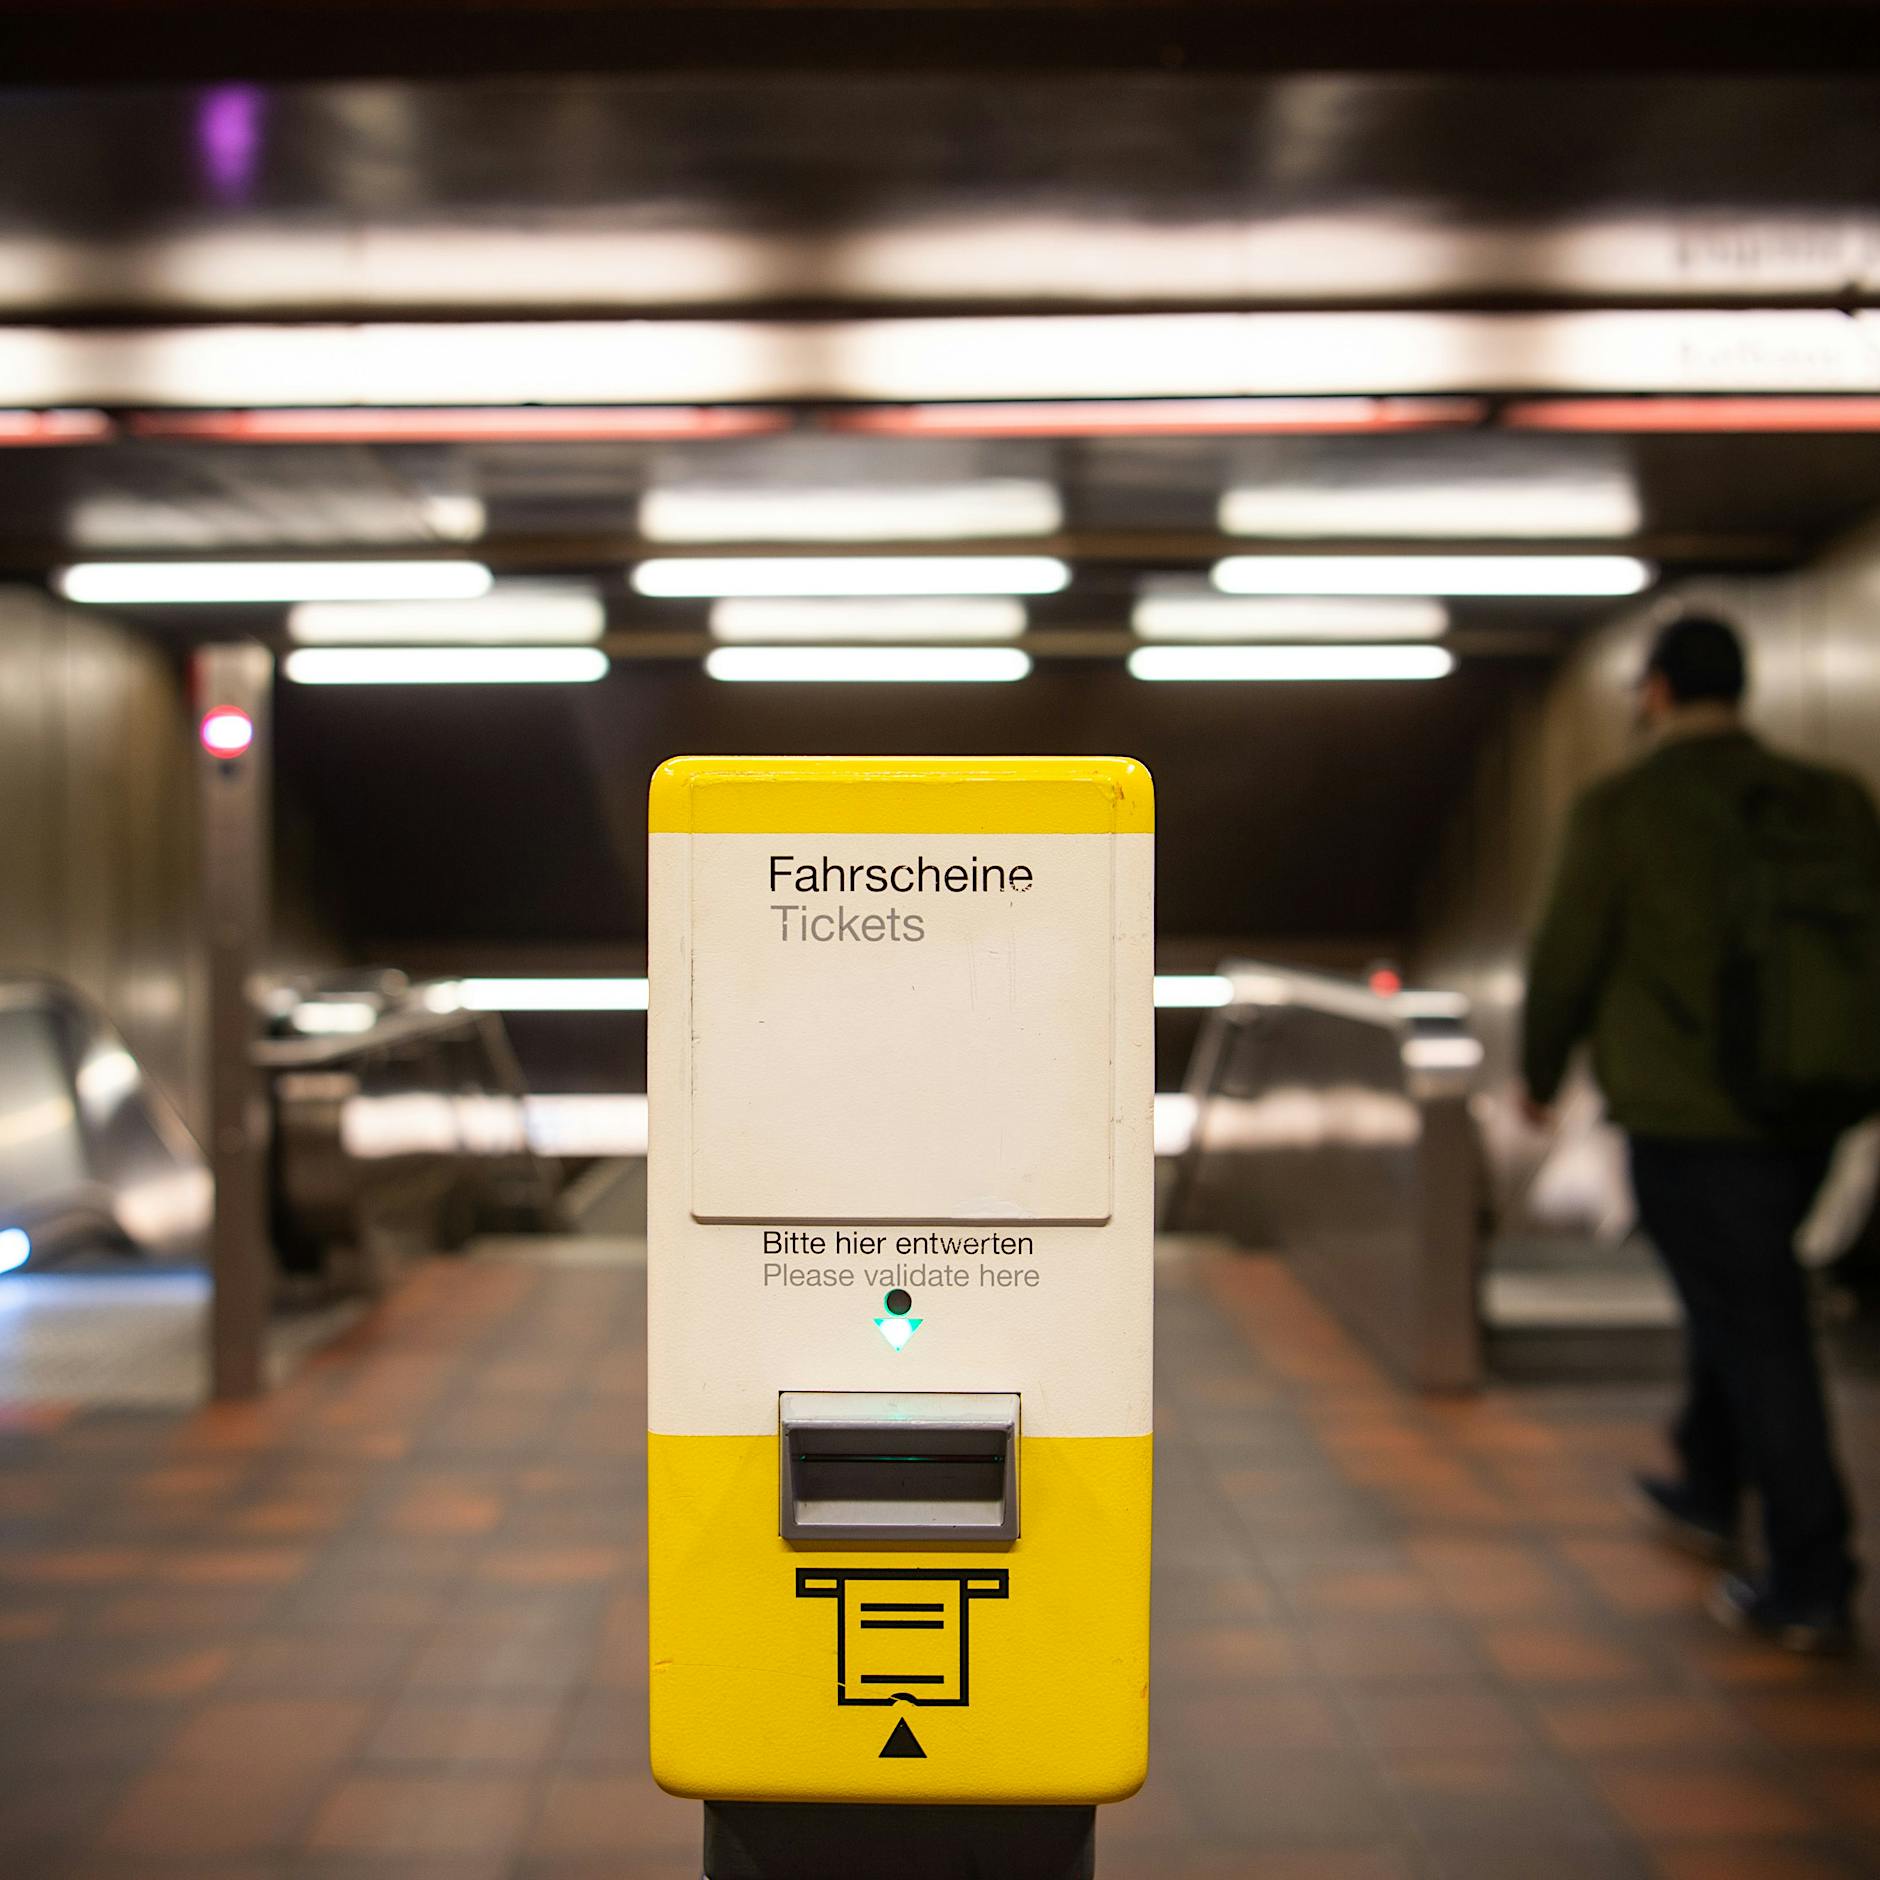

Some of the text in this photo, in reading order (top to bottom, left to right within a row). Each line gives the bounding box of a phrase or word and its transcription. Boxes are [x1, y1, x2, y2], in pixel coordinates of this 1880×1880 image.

[770, 855, 1034, 893] Fahrscheine
[770, 905, 925, 942] Tickets
[763, 1231, 1033, 1255] Bitte hier entwerten
[764, 1263, 1040, 1287] Please validate here
